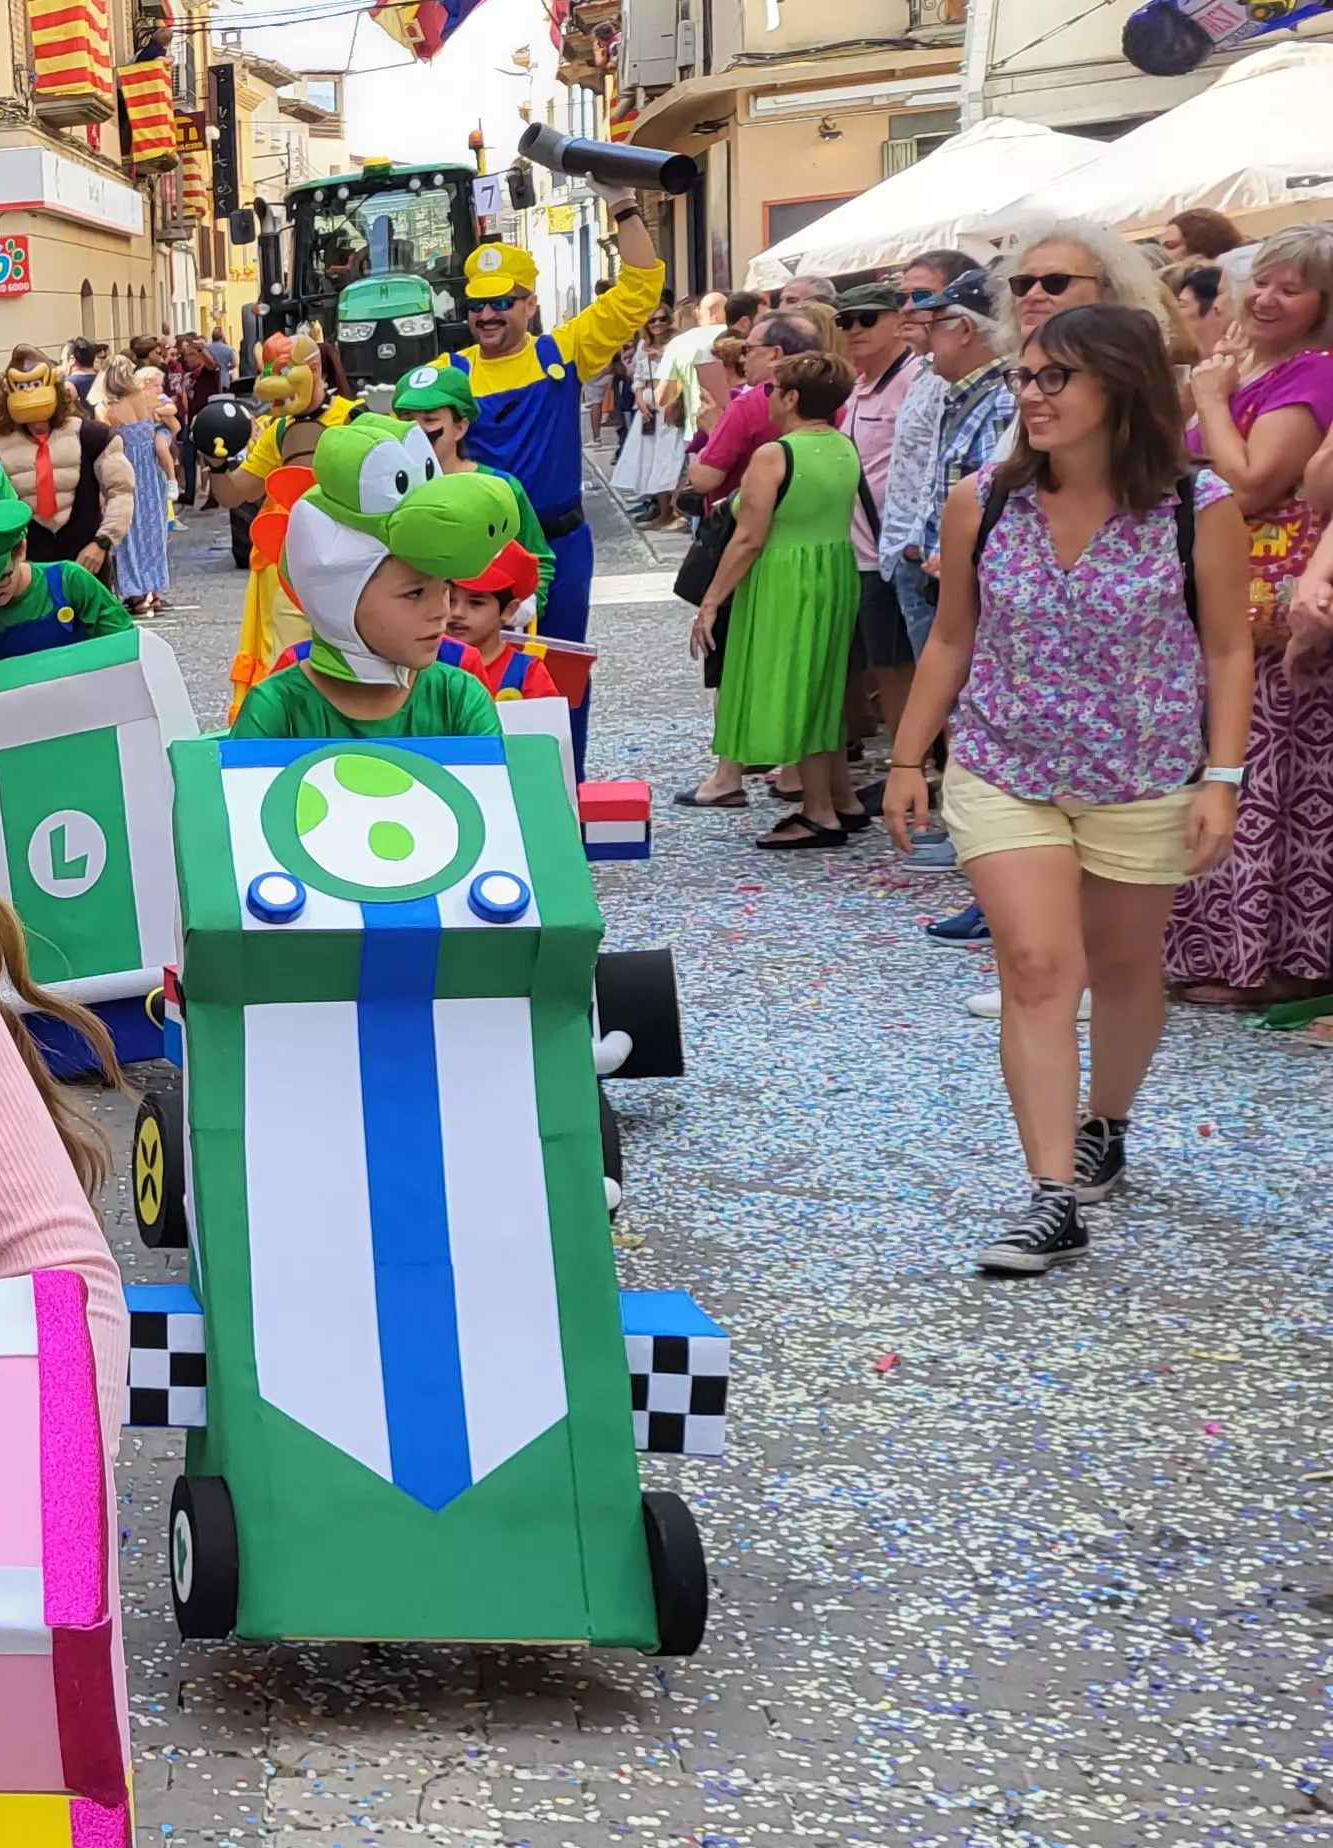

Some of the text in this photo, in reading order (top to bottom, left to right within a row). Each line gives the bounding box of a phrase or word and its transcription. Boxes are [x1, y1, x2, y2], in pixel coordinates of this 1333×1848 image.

[481, 184, 496, 210] 7
[415, 372, 429, 385] L
[49, 823, 89, 880] L
